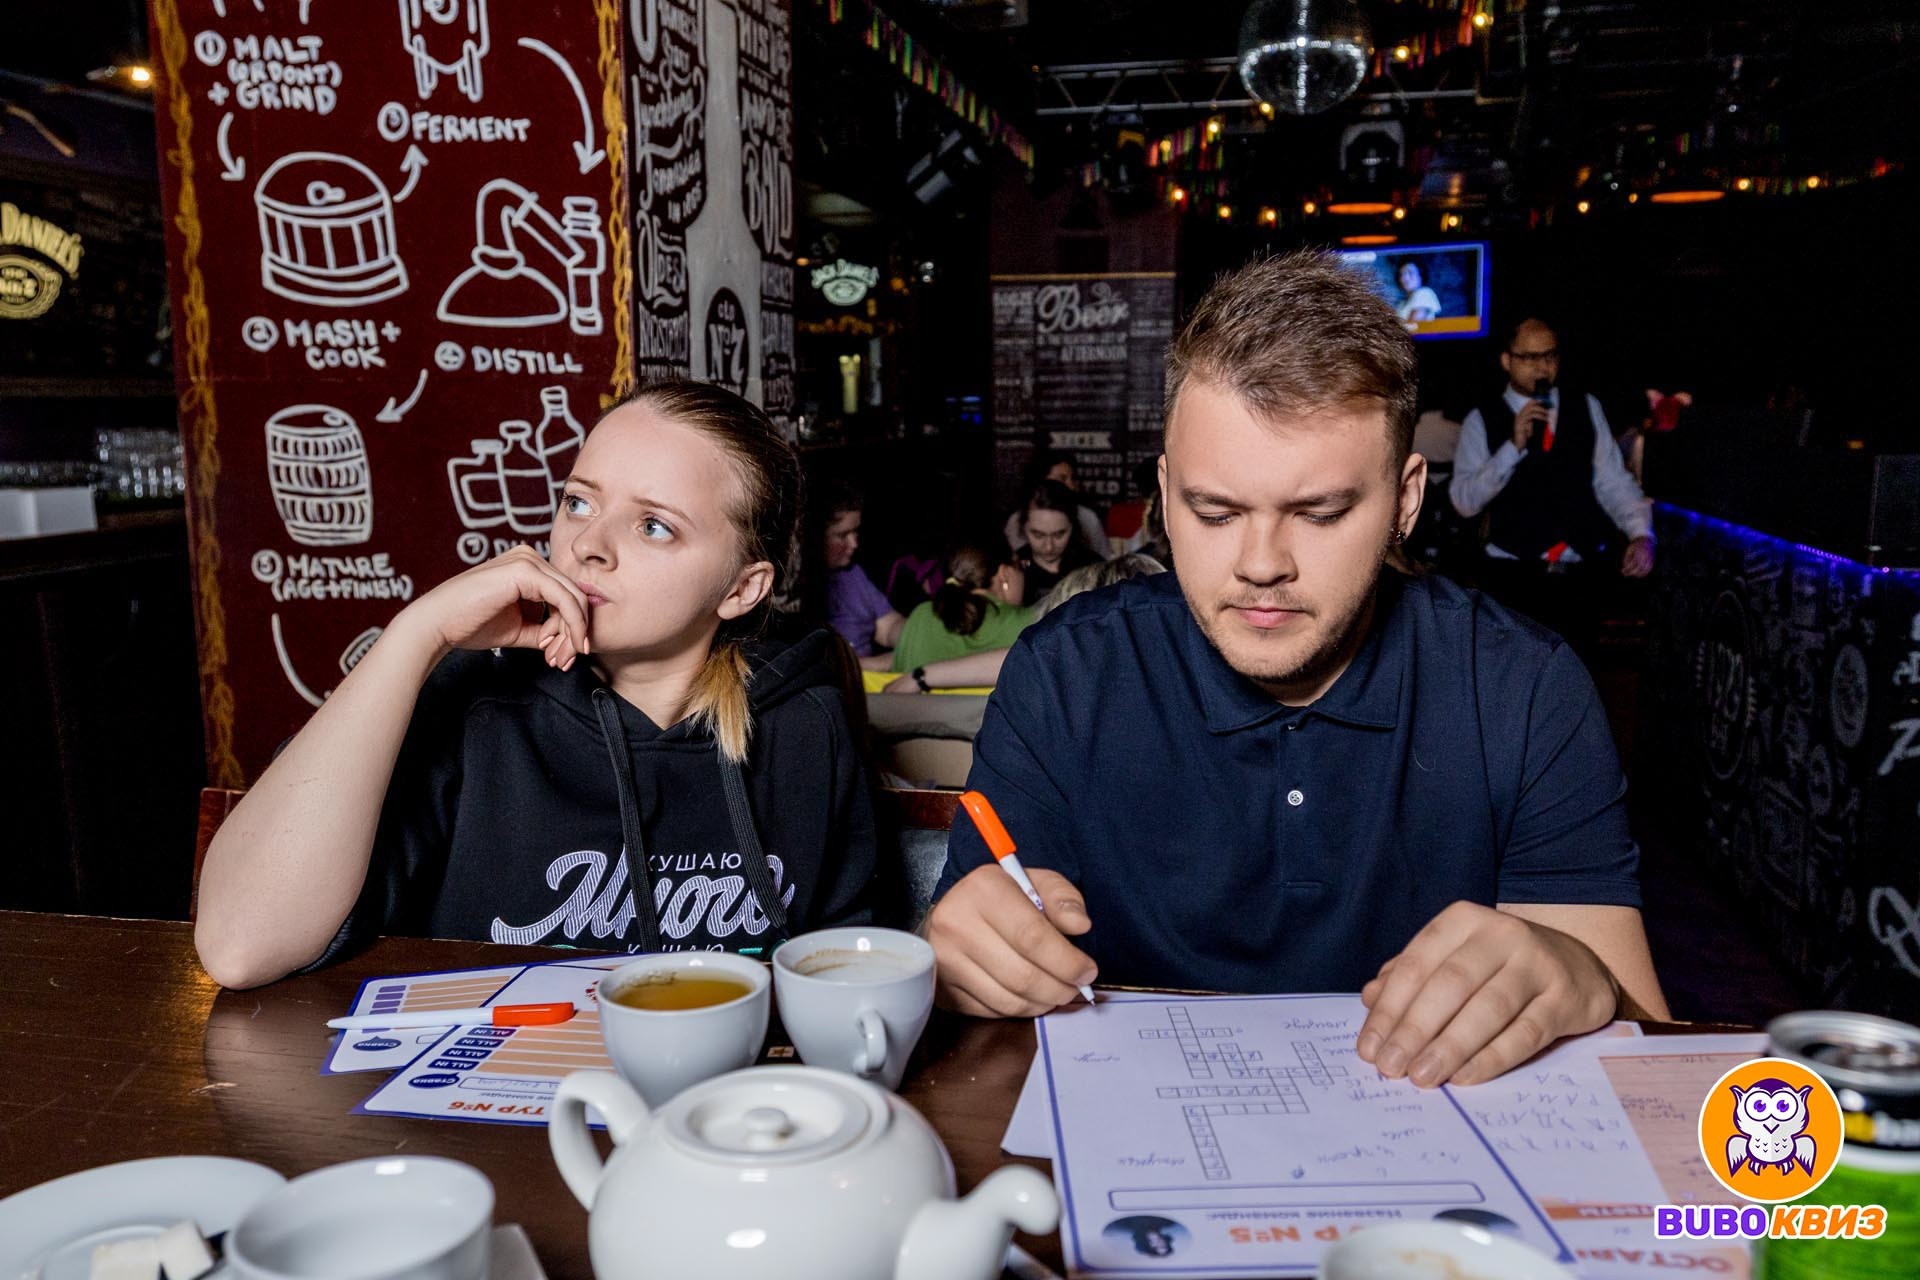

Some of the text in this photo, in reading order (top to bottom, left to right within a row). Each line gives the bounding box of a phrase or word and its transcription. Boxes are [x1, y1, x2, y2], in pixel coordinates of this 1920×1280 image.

[233, 34, 323, 63] MALT
[236, 80, 337, 115] GRIND
[412, 112, 531, 142] FERMENT
[1035, 284, 1129, 333] Beer
[283, 319, 378, 347] MASH
[305, 345, 387, 371] COOK
[471, 346, 583, 374] DISTILL
[286, 553, 395, 578] MATURE
[497, 1104, 544, 1115] ТУР
